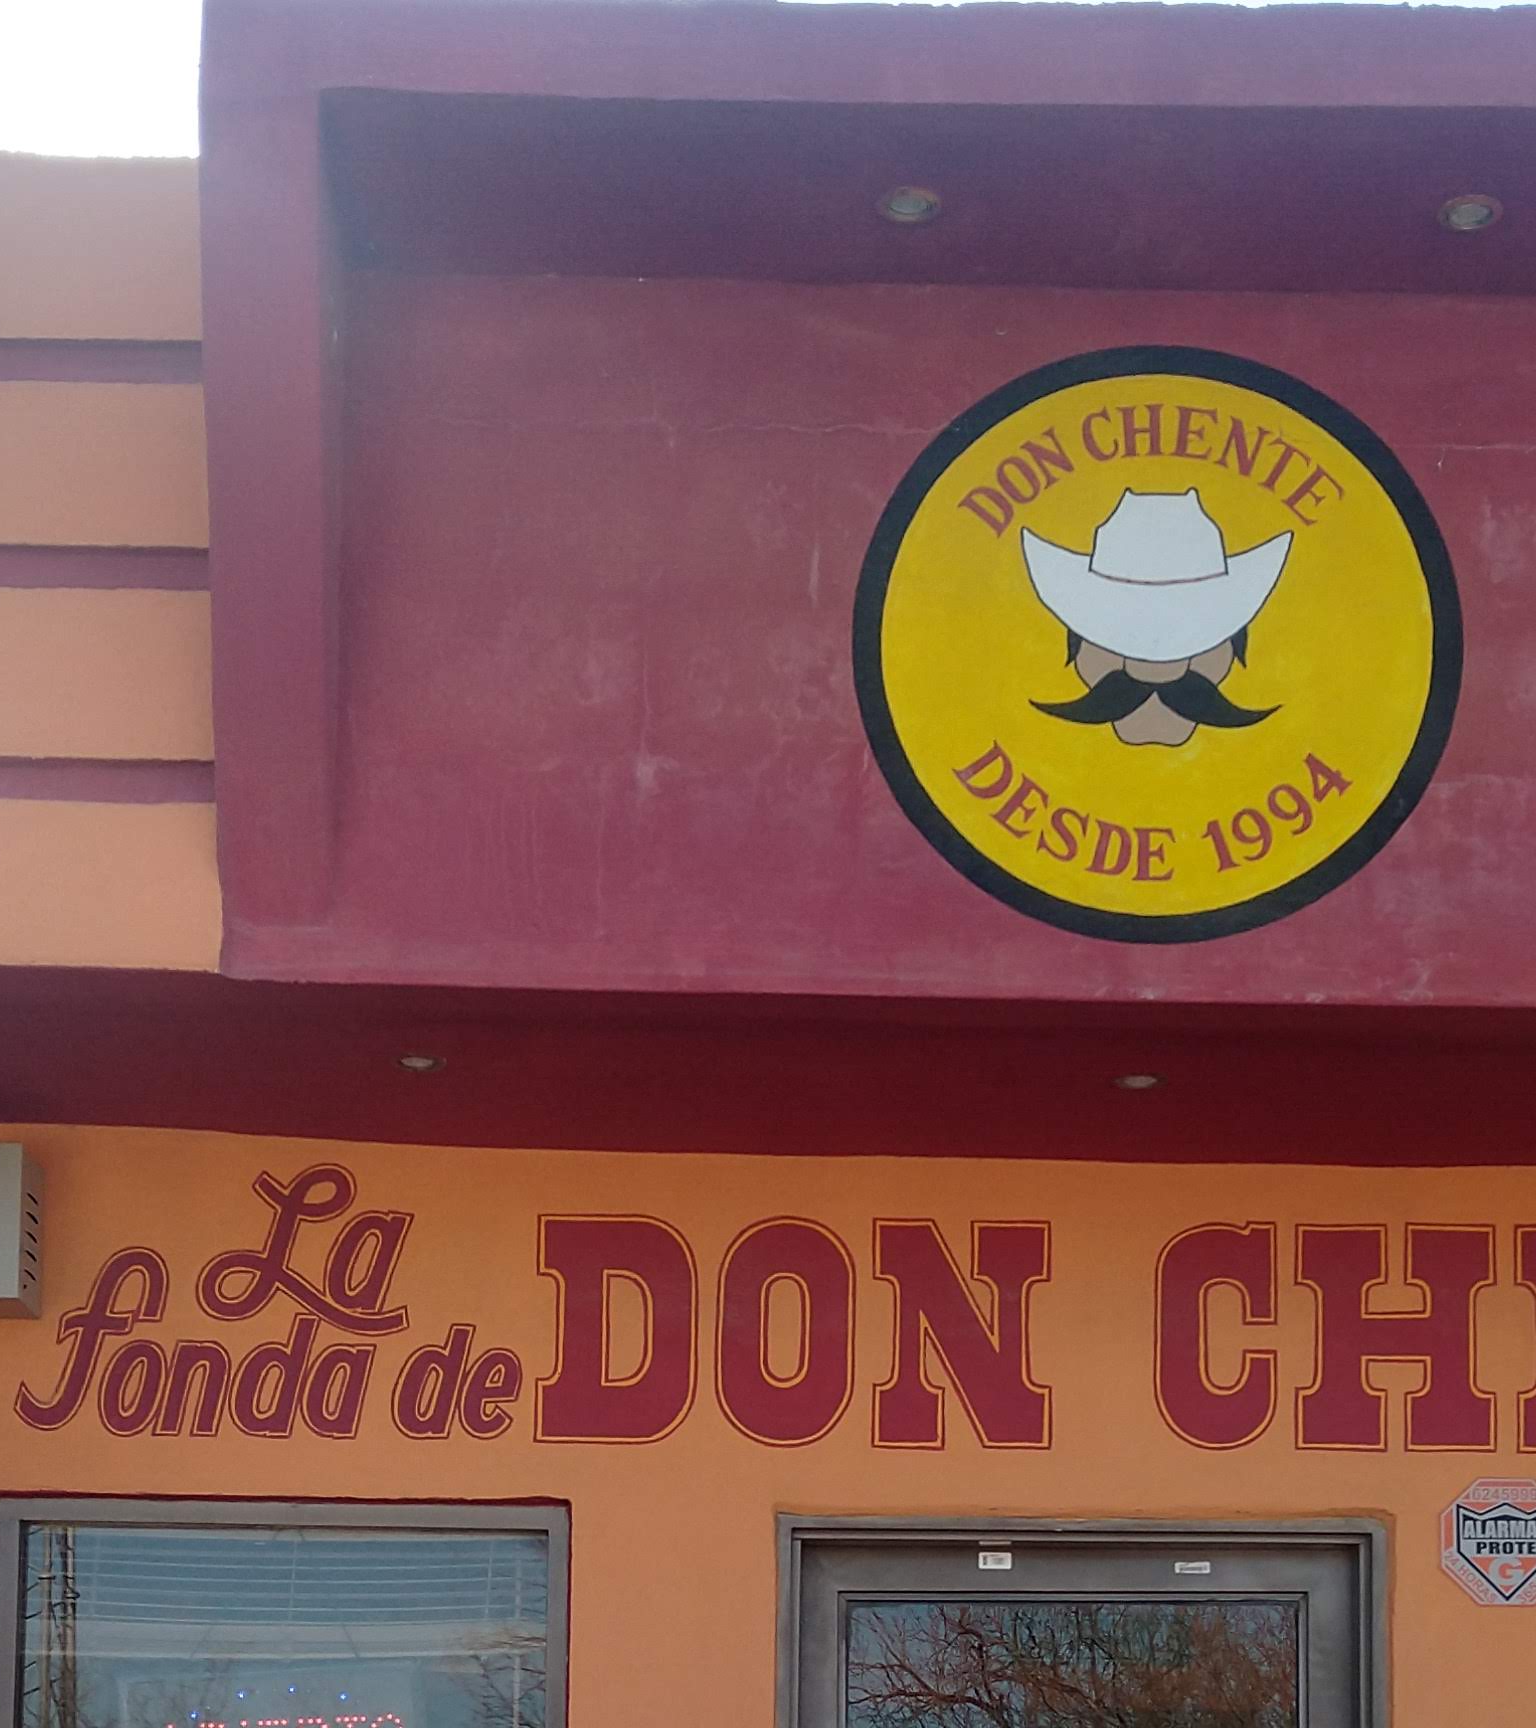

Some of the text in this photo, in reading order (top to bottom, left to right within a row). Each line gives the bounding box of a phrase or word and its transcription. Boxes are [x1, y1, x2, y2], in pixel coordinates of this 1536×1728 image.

[957, 403, 1345, 538] DON CHENTE
[952, 739, 1353, 882] DESDE 1994
[196, 1163, 416, 1334] La
[13, 1245, 524, 1440] fonda de
[532, 1213, 1053, 1451] DON
[1476, 1541, 1536, 1554] PROTE
